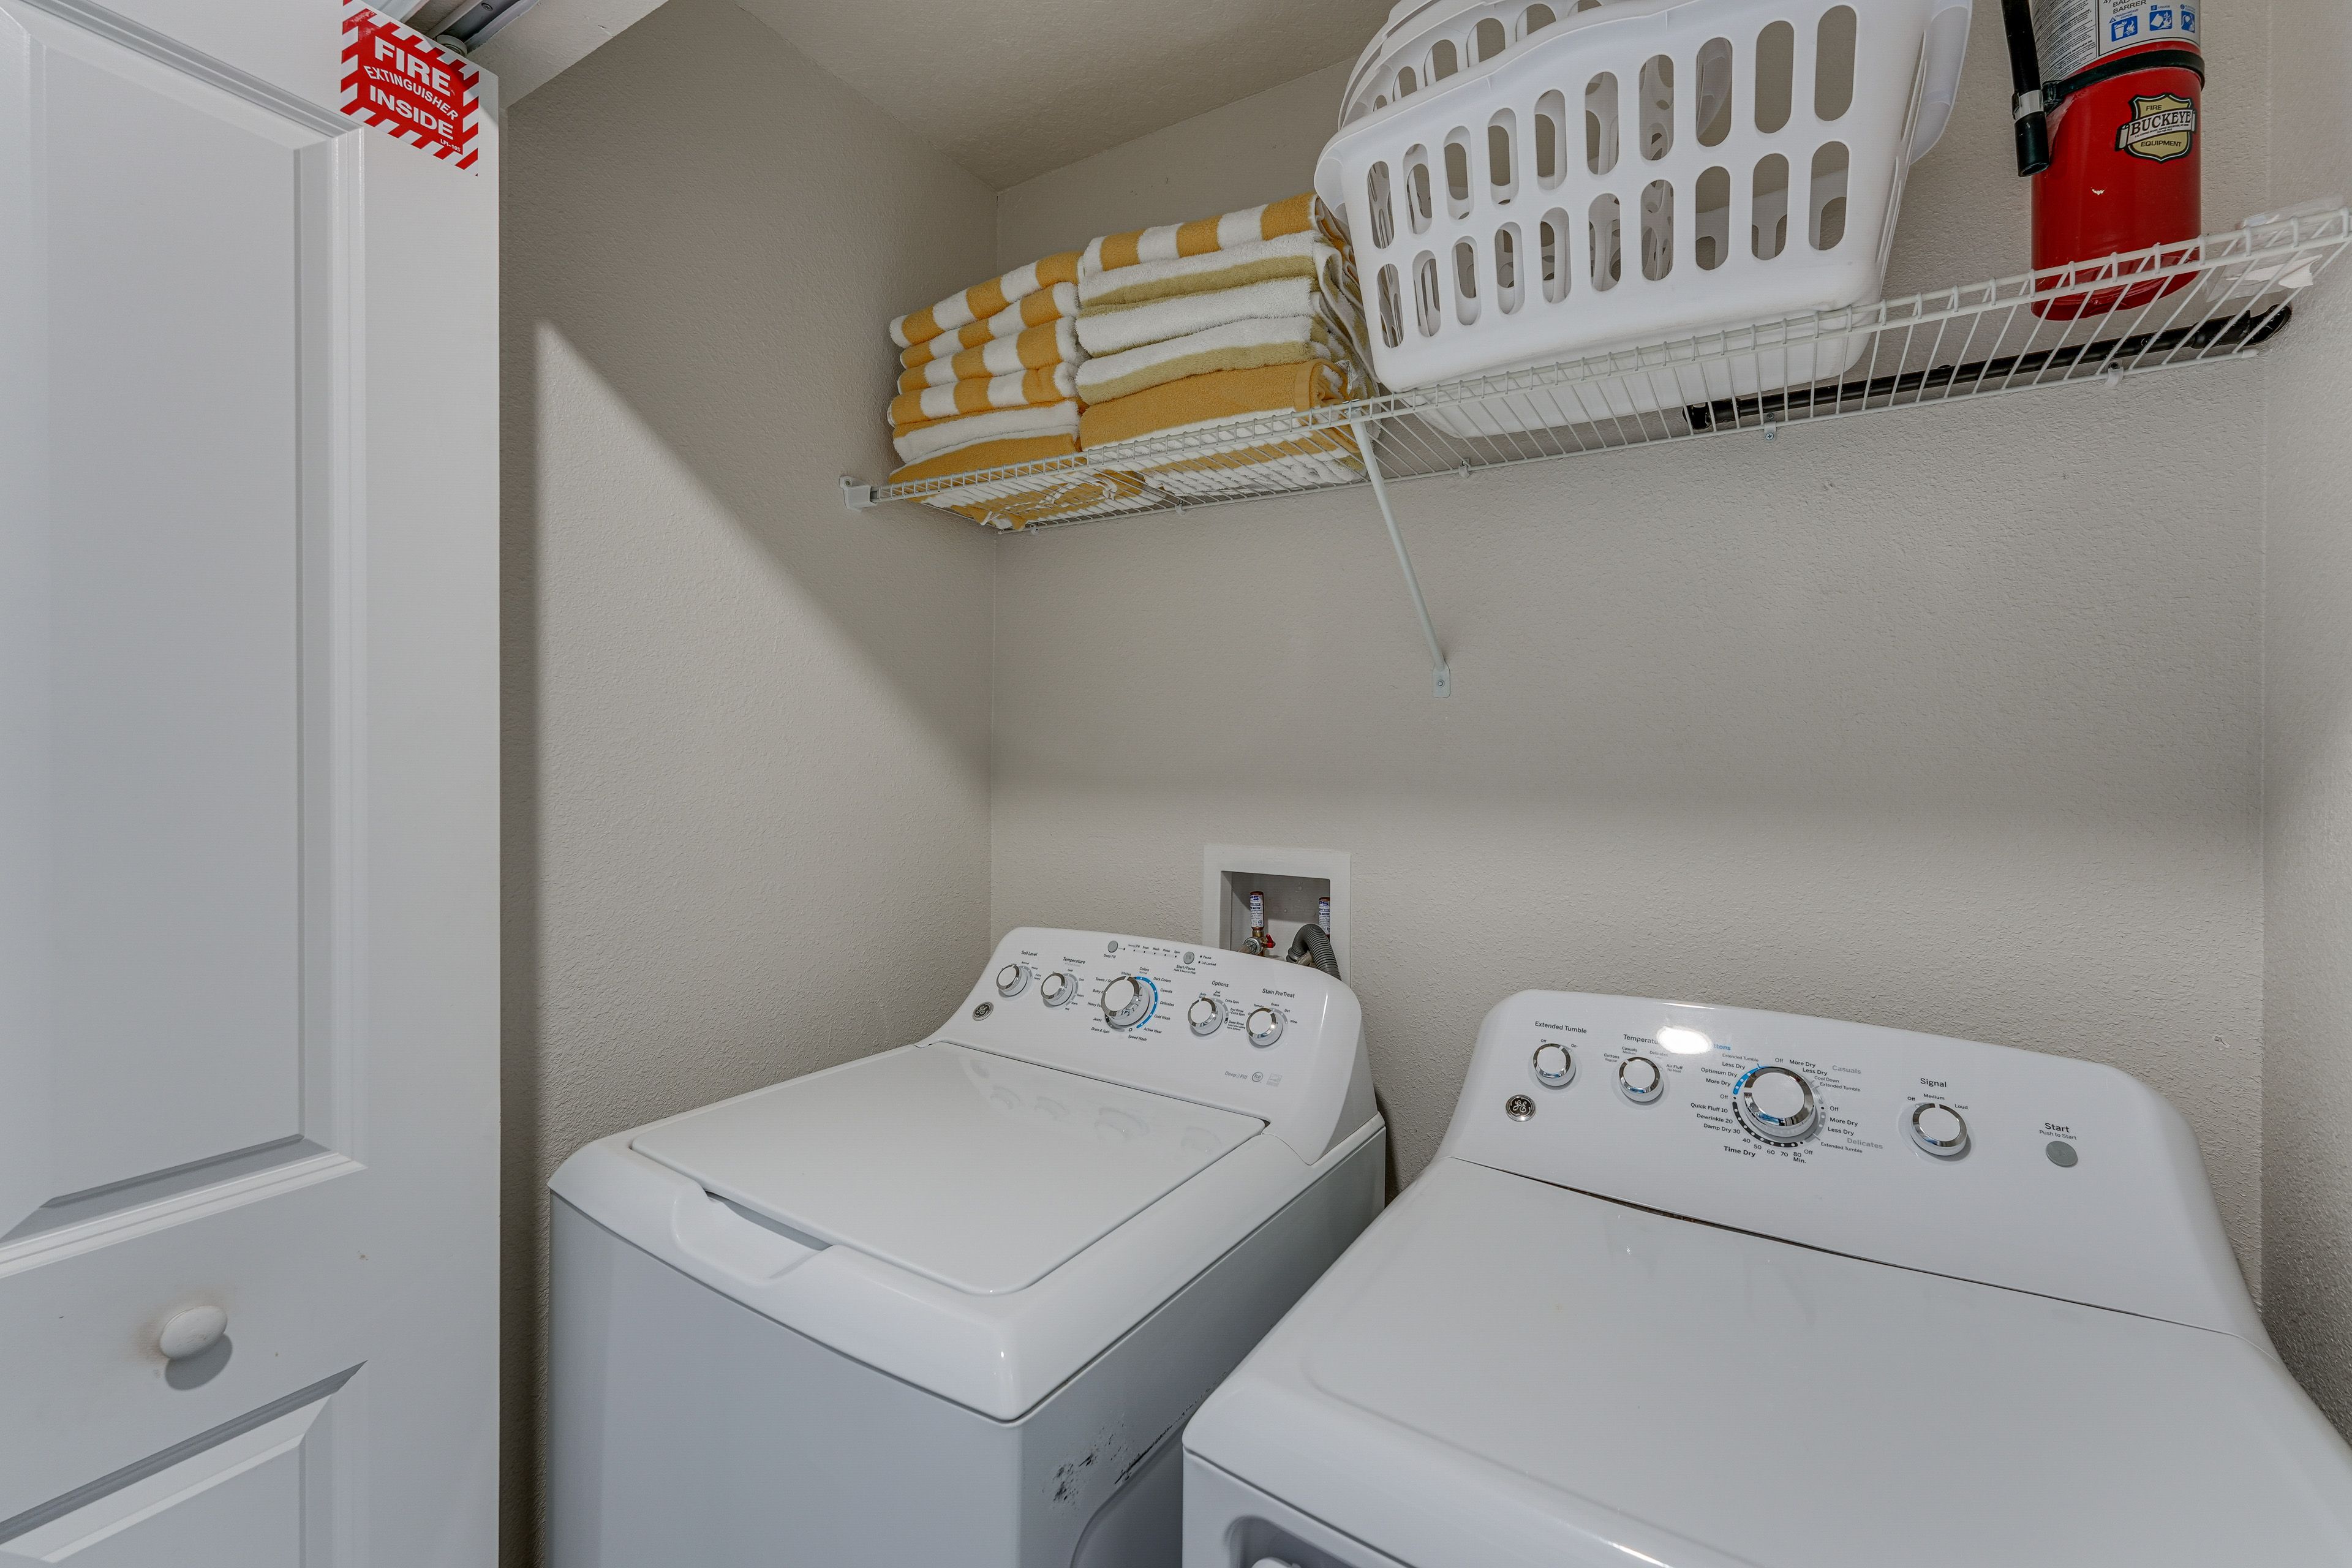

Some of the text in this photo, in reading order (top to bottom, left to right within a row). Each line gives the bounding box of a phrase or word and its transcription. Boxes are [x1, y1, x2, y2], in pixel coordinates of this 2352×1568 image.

[2113, 0, 2146, 14] BARRER
[375, 36, 451, 97] FIRE
[364, 66, 458, 120] EXTINGUISHER
[370, 85, 453, 140] INSIDE
[2130, 111, 2192, 136] BUCKEYE
[1535, 1021, 1587, 1034] Extended Tumble
[1624, 1034, 1659, 1045] Temperatu
[1701, 1067, 1727, 1076] Optimum
[1832, 1065, 1861, 1074] Casuals
[1920, 1077, 1947, 1088] Signal
[1697, 1114, 1724, 1123] Dewrinkle
[2045, 1122, 2070, 1133] Start
[1847, 1137, 1883, 1149] Delicates
[1724, 1145, 1756, 1158] Time Dry
